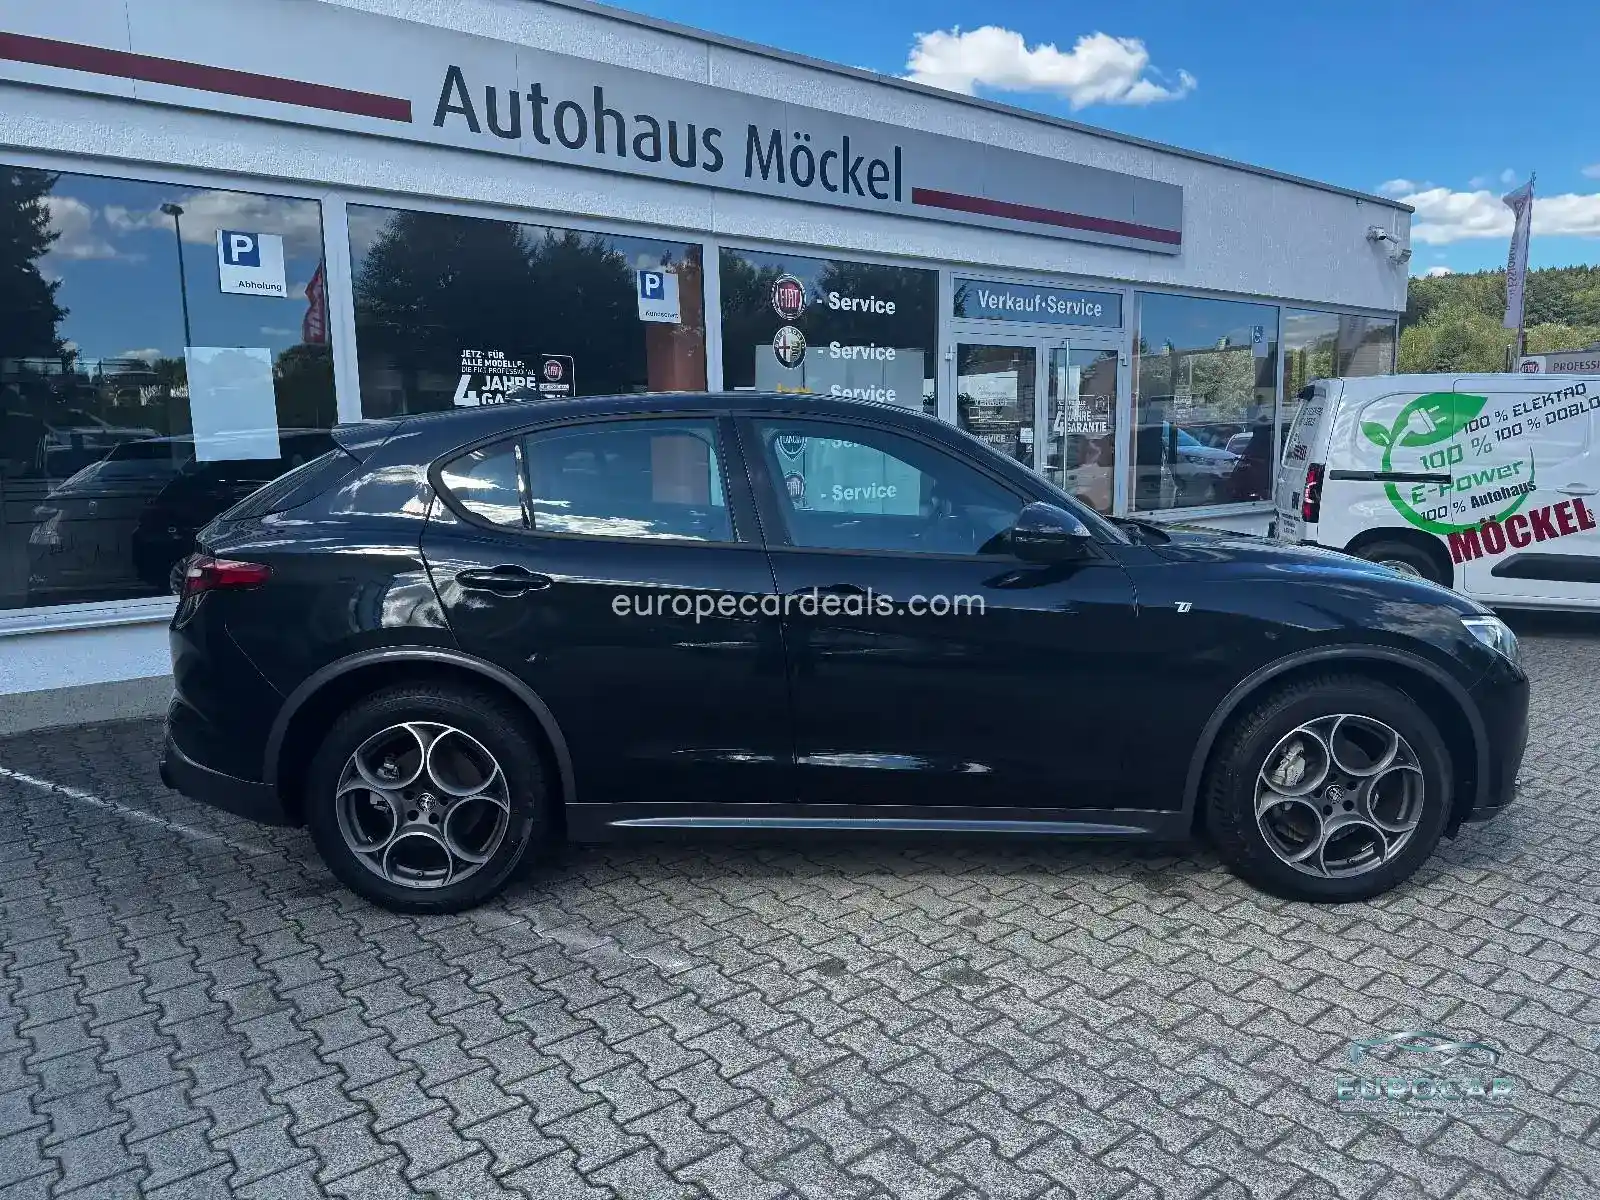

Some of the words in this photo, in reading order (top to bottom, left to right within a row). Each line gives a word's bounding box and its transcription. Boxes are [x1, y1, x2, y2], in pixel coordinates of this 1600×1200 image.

[433, 65, 724, 173] Autohaus
[745, 124, 902, 202] Möckel
[231, 234, 253, 262] P
[238, 280, 282, 292] Abholung
[645, 273, 660, 296] P
[780, 288, 799, 308] FIAT
[828, 291, 896, 315] Service
[461, 358, 483, 367] ALLE
[488, 350, 505, 360] FÜR
[829, 341, 896, 361] Service
[488, 367, 536, 377] PROFESSIOAL
[454, 374, 480, 406] 4
[481, 375, 537, 391] JAHRE
[830, 384, 897, 402] Service
[1463, 415, 1491, 435] 100
[1512, 383, 1587, 418] ELEKTRO
[1494, 423, 1523, 442] 100
[1545, 396, 1600, 425] DOBLO
[979, 433, 1006, 443] ERVICE
[1067, 421, 1107, 433] GARANTIE
[1419, 443, 1464, 471] 100
[831, 483, 898, 501] Service
[1421, 505, 1448, 521] 100
[1470, 480, 1537, 509] Autohaus
[1447, 497, 1597, 565] MÖCKEL
